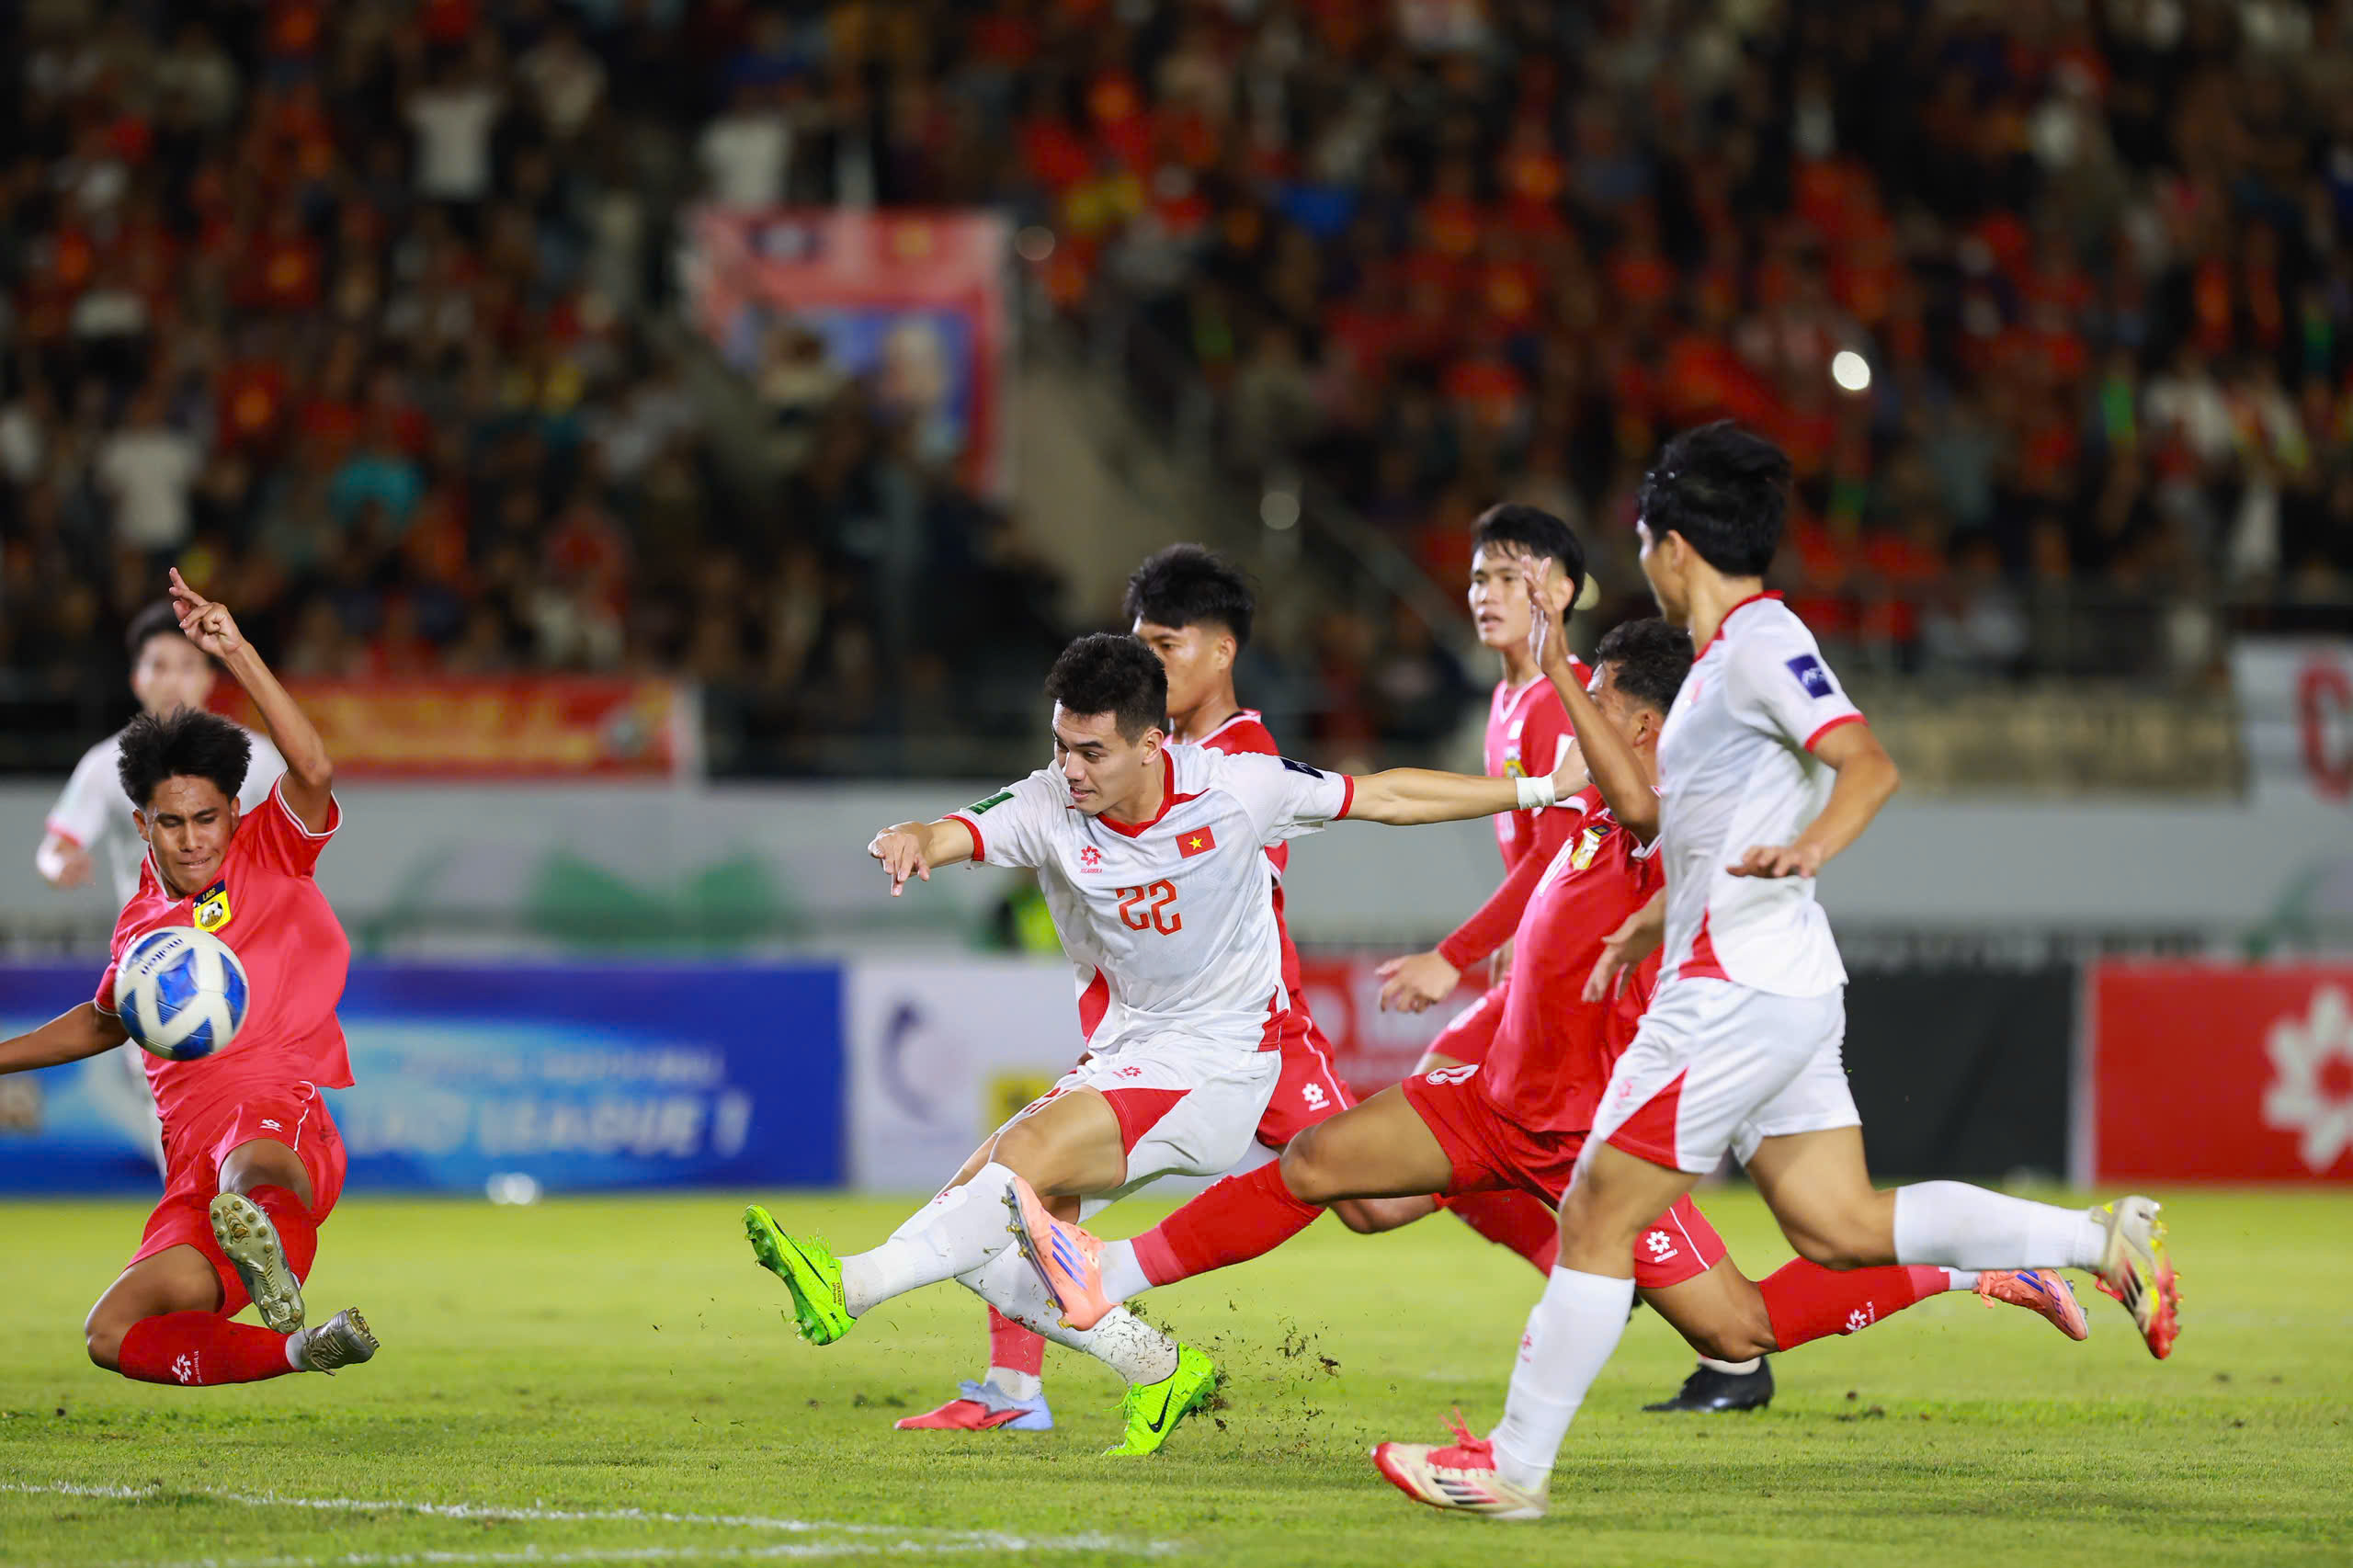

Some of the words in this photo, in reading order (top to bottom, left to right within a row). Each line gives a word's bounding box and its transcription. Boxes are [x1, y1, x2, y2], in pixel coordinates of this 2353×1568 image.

[202, 887, 217, 902] LAOS
[1115, 878, 1183, 937] 22
[141, 937, 184, 975] molten
